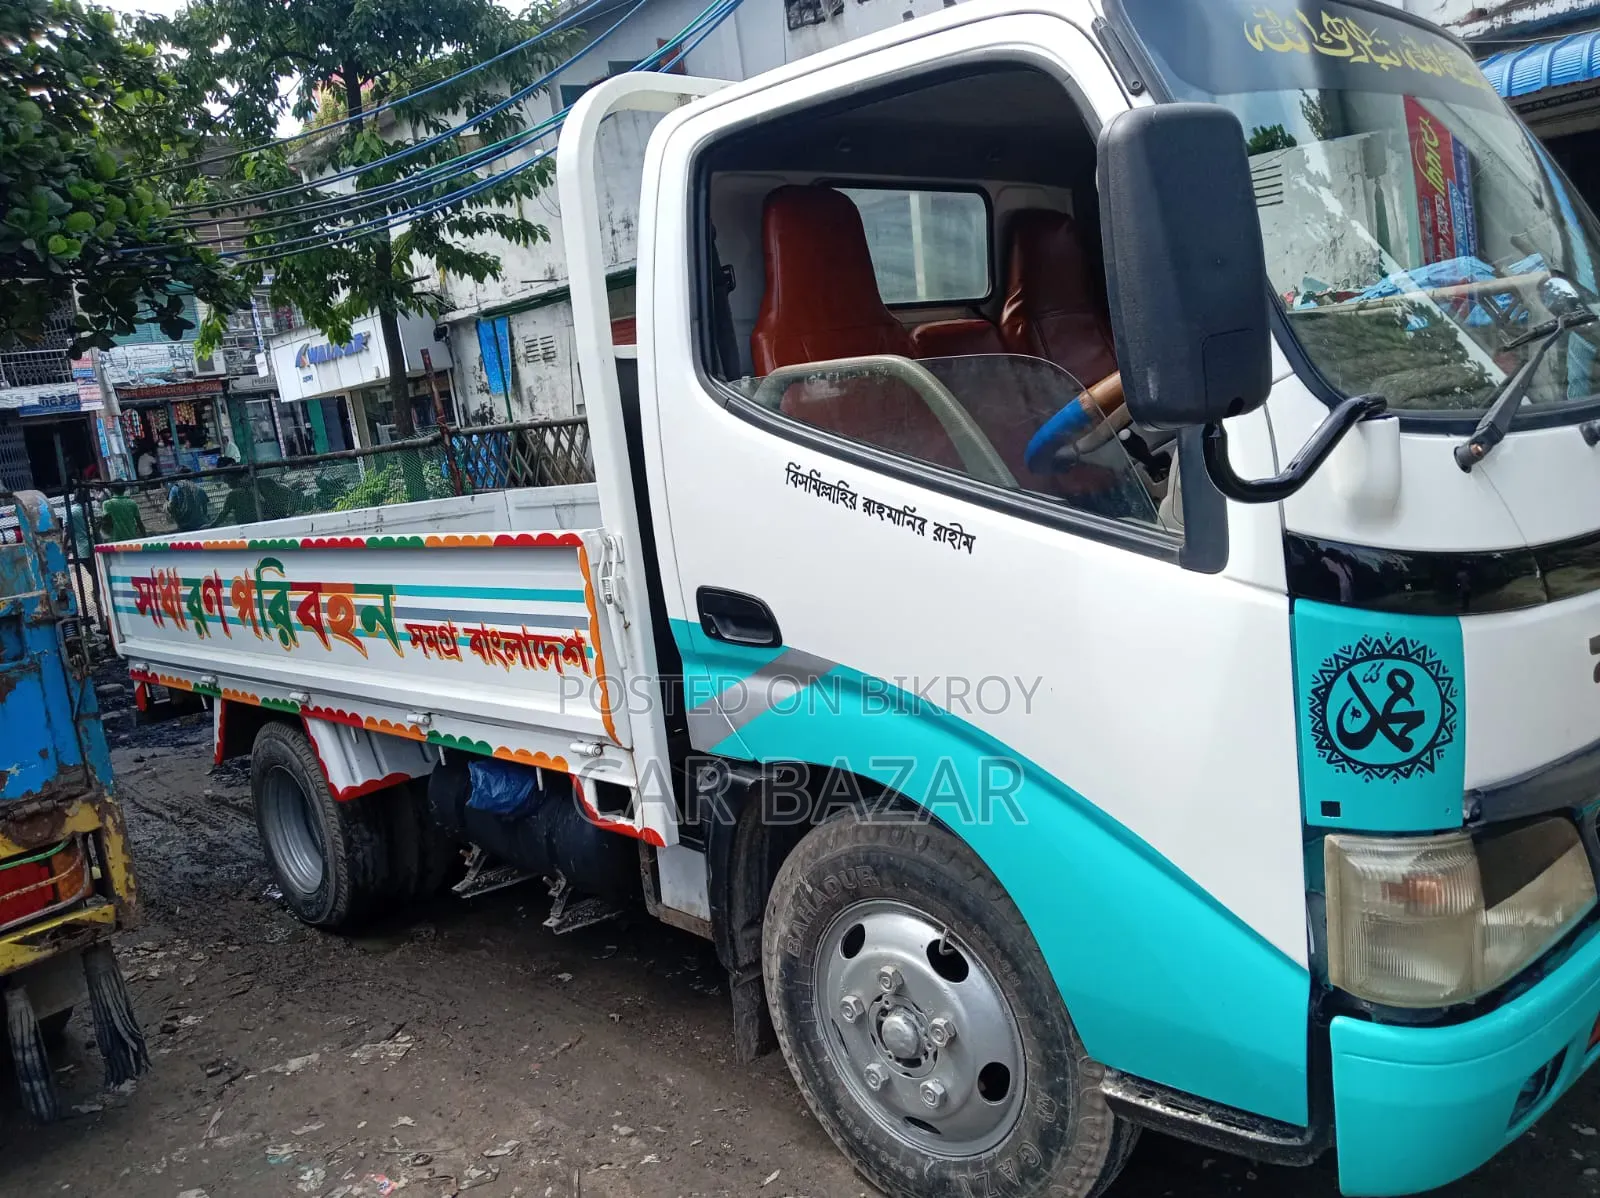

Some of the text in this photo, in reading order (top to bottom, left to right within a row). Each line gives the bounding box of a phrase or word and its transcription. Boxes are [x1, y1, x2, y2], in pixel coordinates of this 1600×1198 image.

[785, 461, 976, 555] বিসমিল্লাহির রাহমানির রাহীম
[131, 556, 593, 679] সাধারণ পরিবহন সমগ্র বাংলাদেশ
[785, 865, 881, 959] BAHADUR
[956, 1140, 1043, 1198] GAZI
